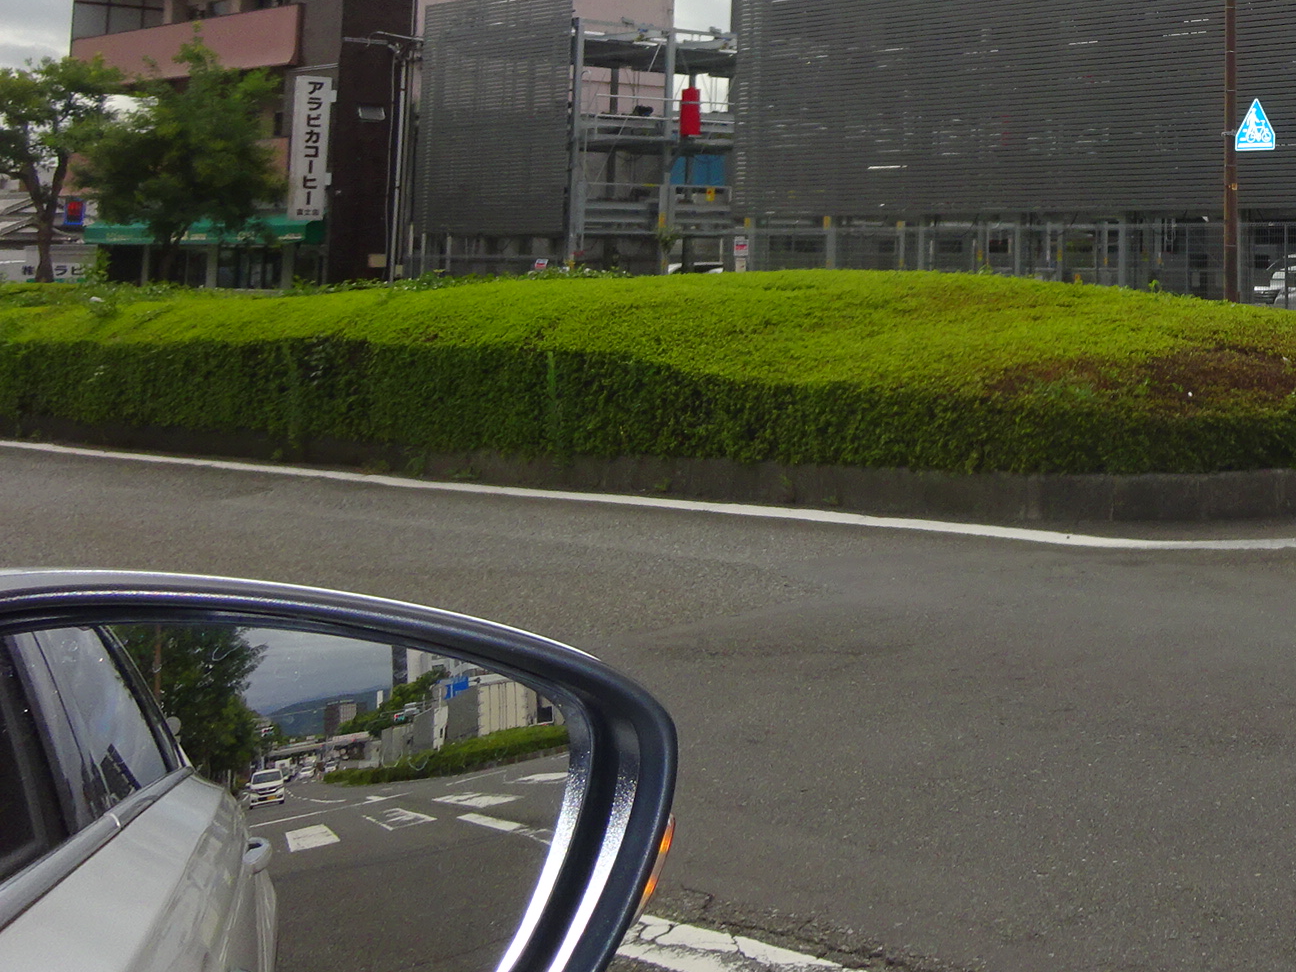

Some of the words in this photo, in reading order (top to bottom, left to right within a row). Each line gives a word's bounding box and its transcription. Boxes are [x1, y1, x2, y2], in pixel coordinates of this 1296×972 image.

[302, 81, 324, 206] アラビカコーヒー
